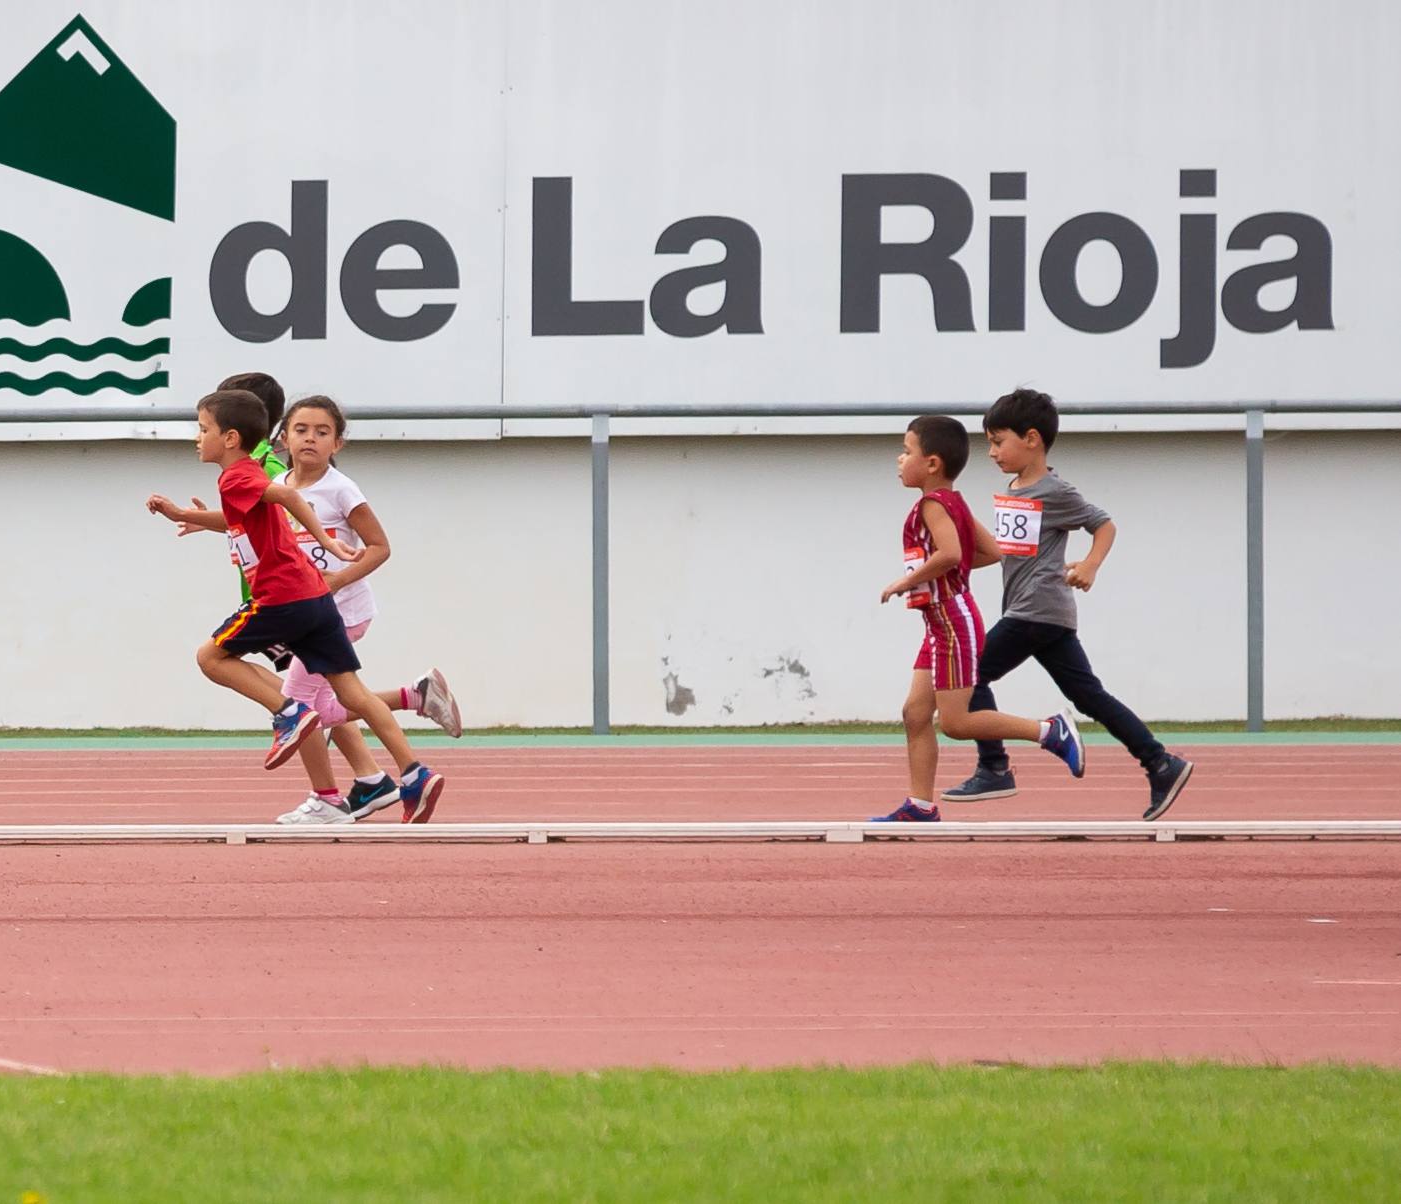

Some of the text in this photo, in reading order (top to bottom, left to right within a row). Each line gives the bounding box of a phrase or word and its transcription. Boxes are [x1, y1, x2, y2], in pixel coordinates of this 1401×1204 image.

[209, 180, 459, 343] de
[532, 177, 763, 338] La
[840, 170, 1335, 369] Rioja
